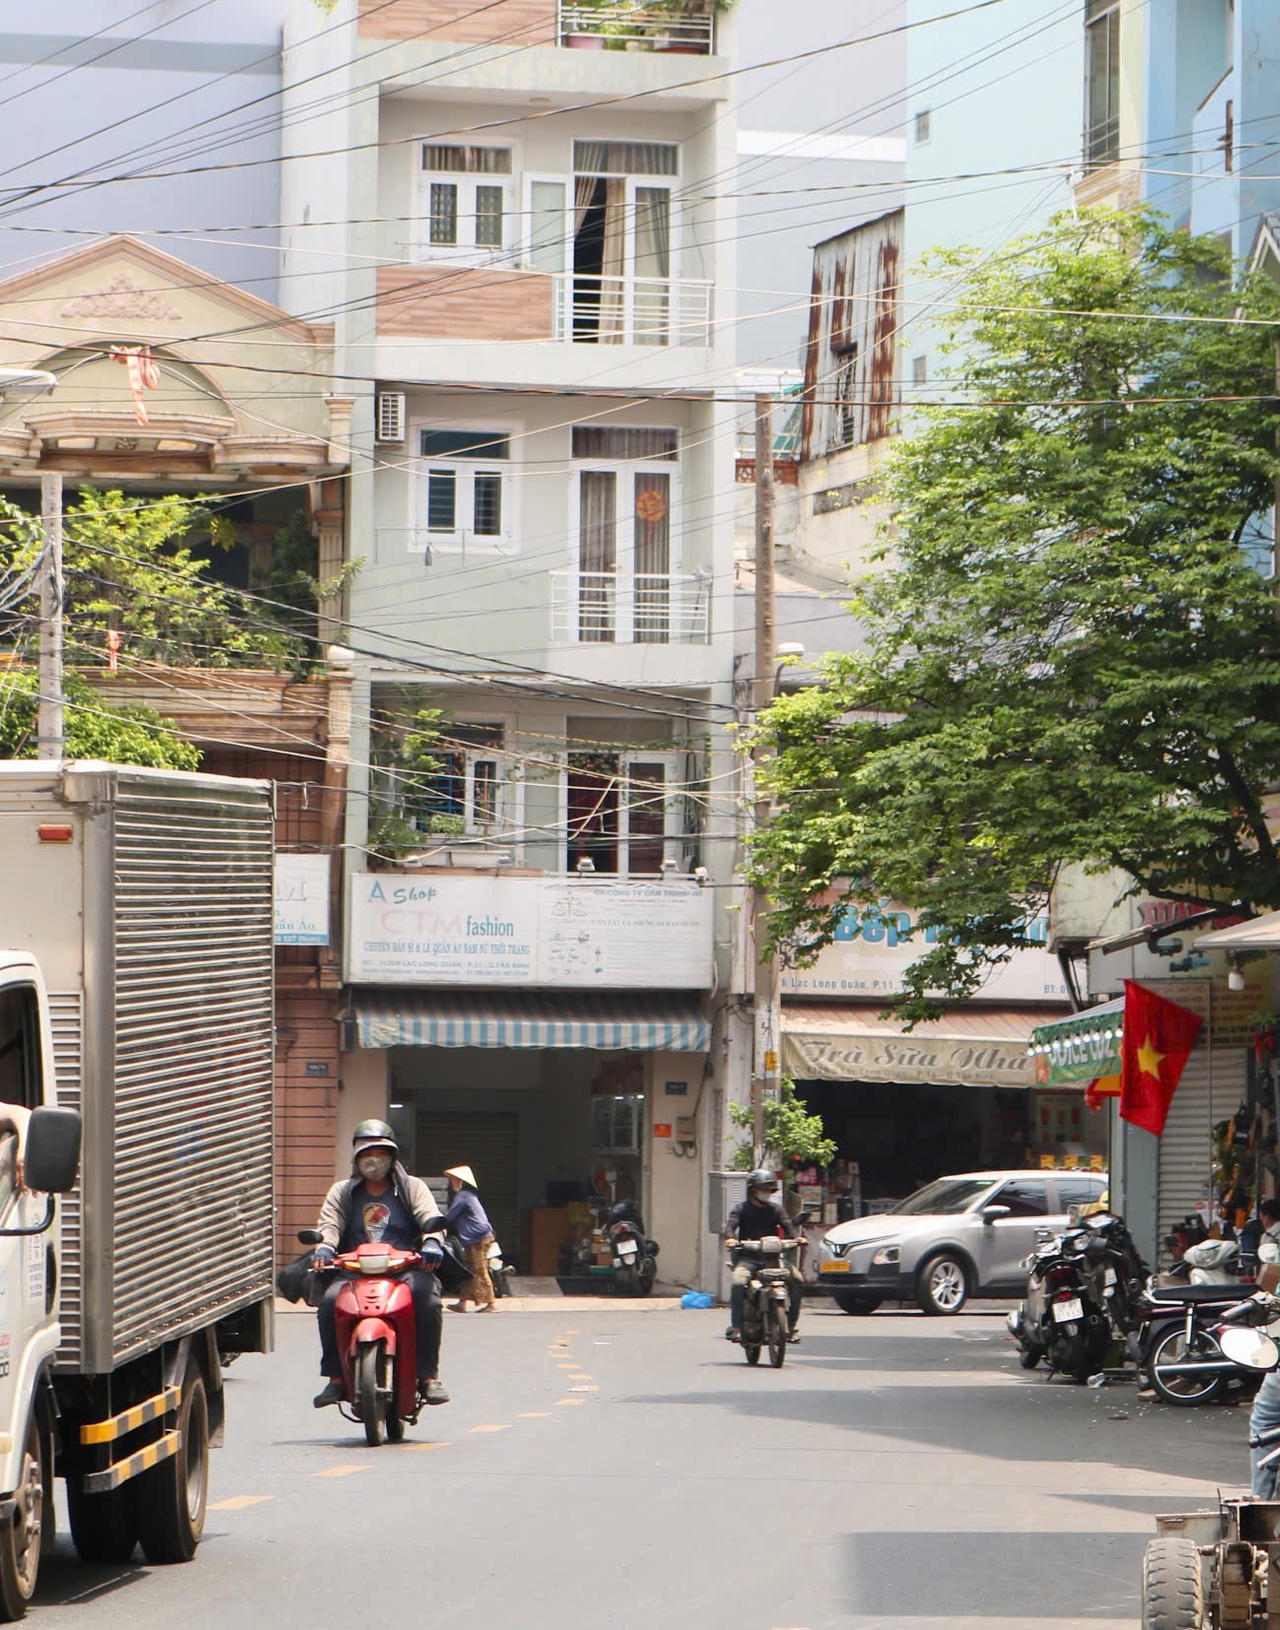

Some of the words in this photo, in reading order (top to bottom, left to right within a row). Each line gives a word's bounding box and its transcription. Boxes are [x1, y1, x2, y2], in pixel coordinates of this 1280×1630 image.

[366, 879, 387, 904] A
[393, 885, 437, 905] Shop
[381, 907, 463, 937] CTM
[465, 914, 515, 937] fashion
[812, 977, 837, 990] Long
[803, 1040, 865, 1066] Trà
[874, 1044, 942, 1067] Sữa
[950, 1046, 1033, 1072] Nhà
